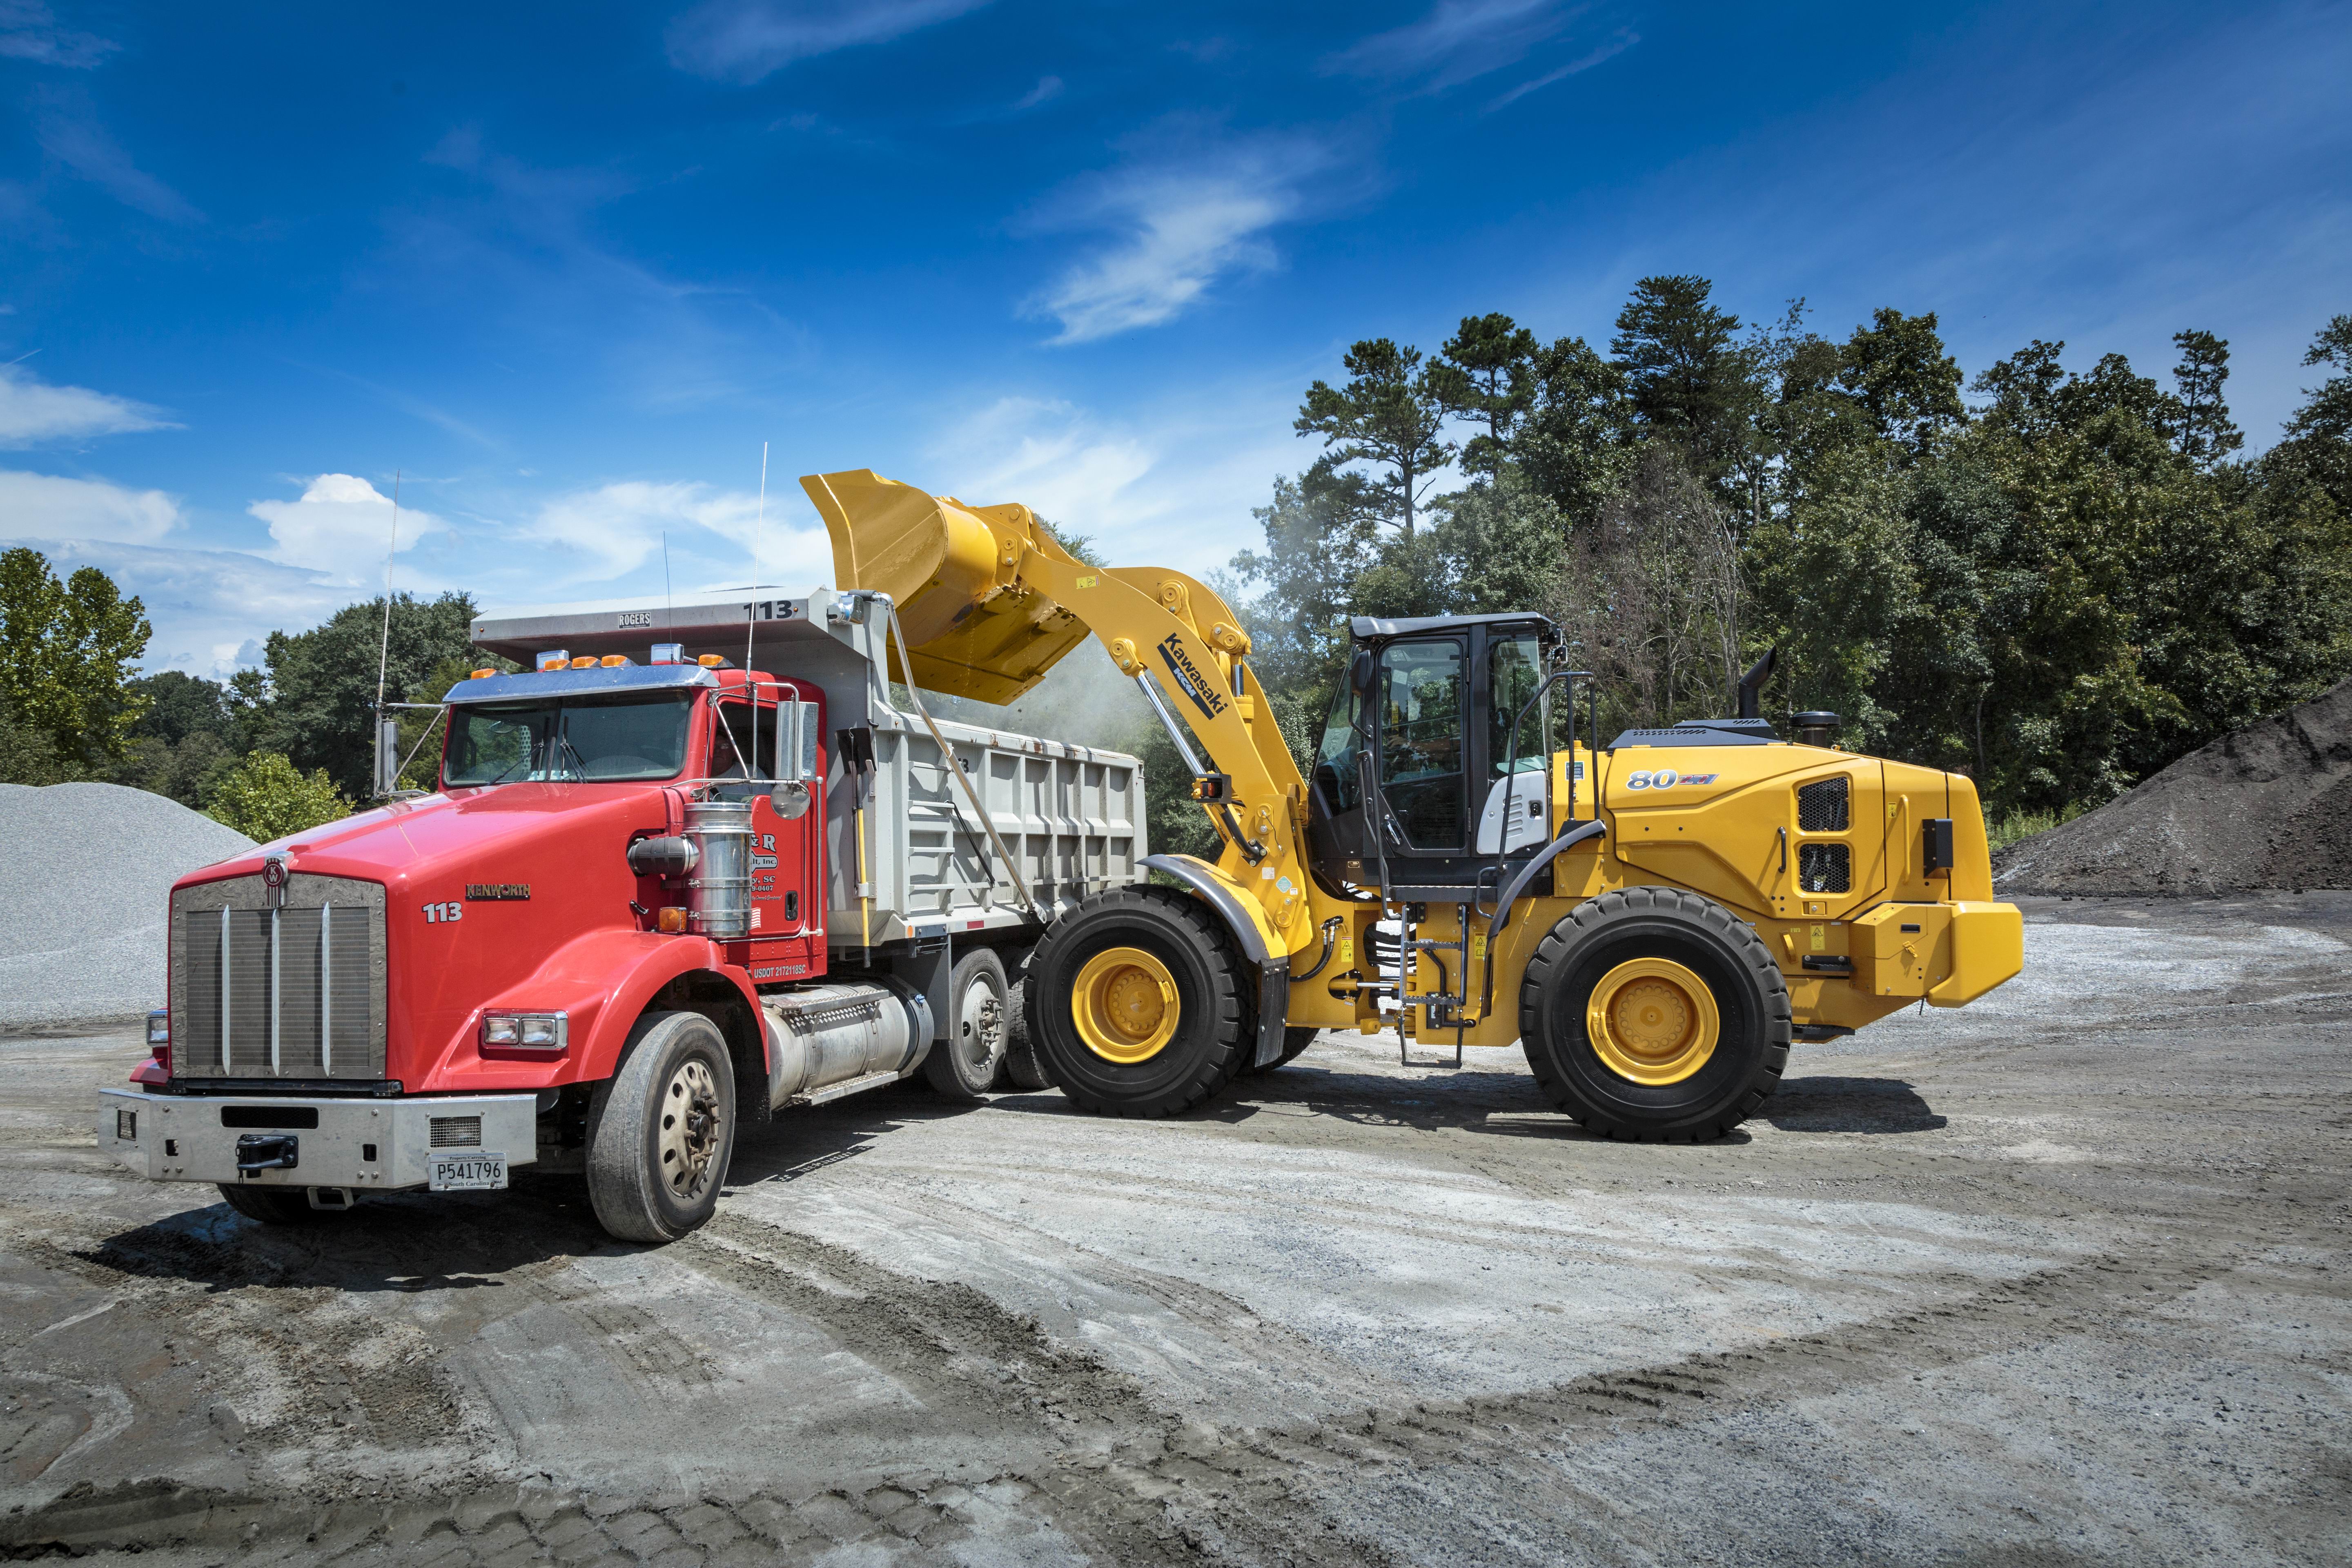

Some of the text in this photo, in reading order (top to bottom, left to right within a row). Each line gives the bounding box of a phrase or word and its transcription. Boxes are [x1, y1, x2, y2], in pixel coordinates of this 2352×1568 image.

[619, 613, 650, 626] ROGERS
[744, 600, 793, 621] 113
[1164, 632, 1228, 714] Kawasaki
[1173, 667, 1196, 697] KCM
[1626, 769, 1677, 791] 80
[762, 833, 776, 853] R
[466, 884, 530, 896] KENWORTH
[422, 901, 463, 924] 113
[754, 964, 806, 978] USDOT 2172118SC
[438, 1162, 501, 1180] P541796
